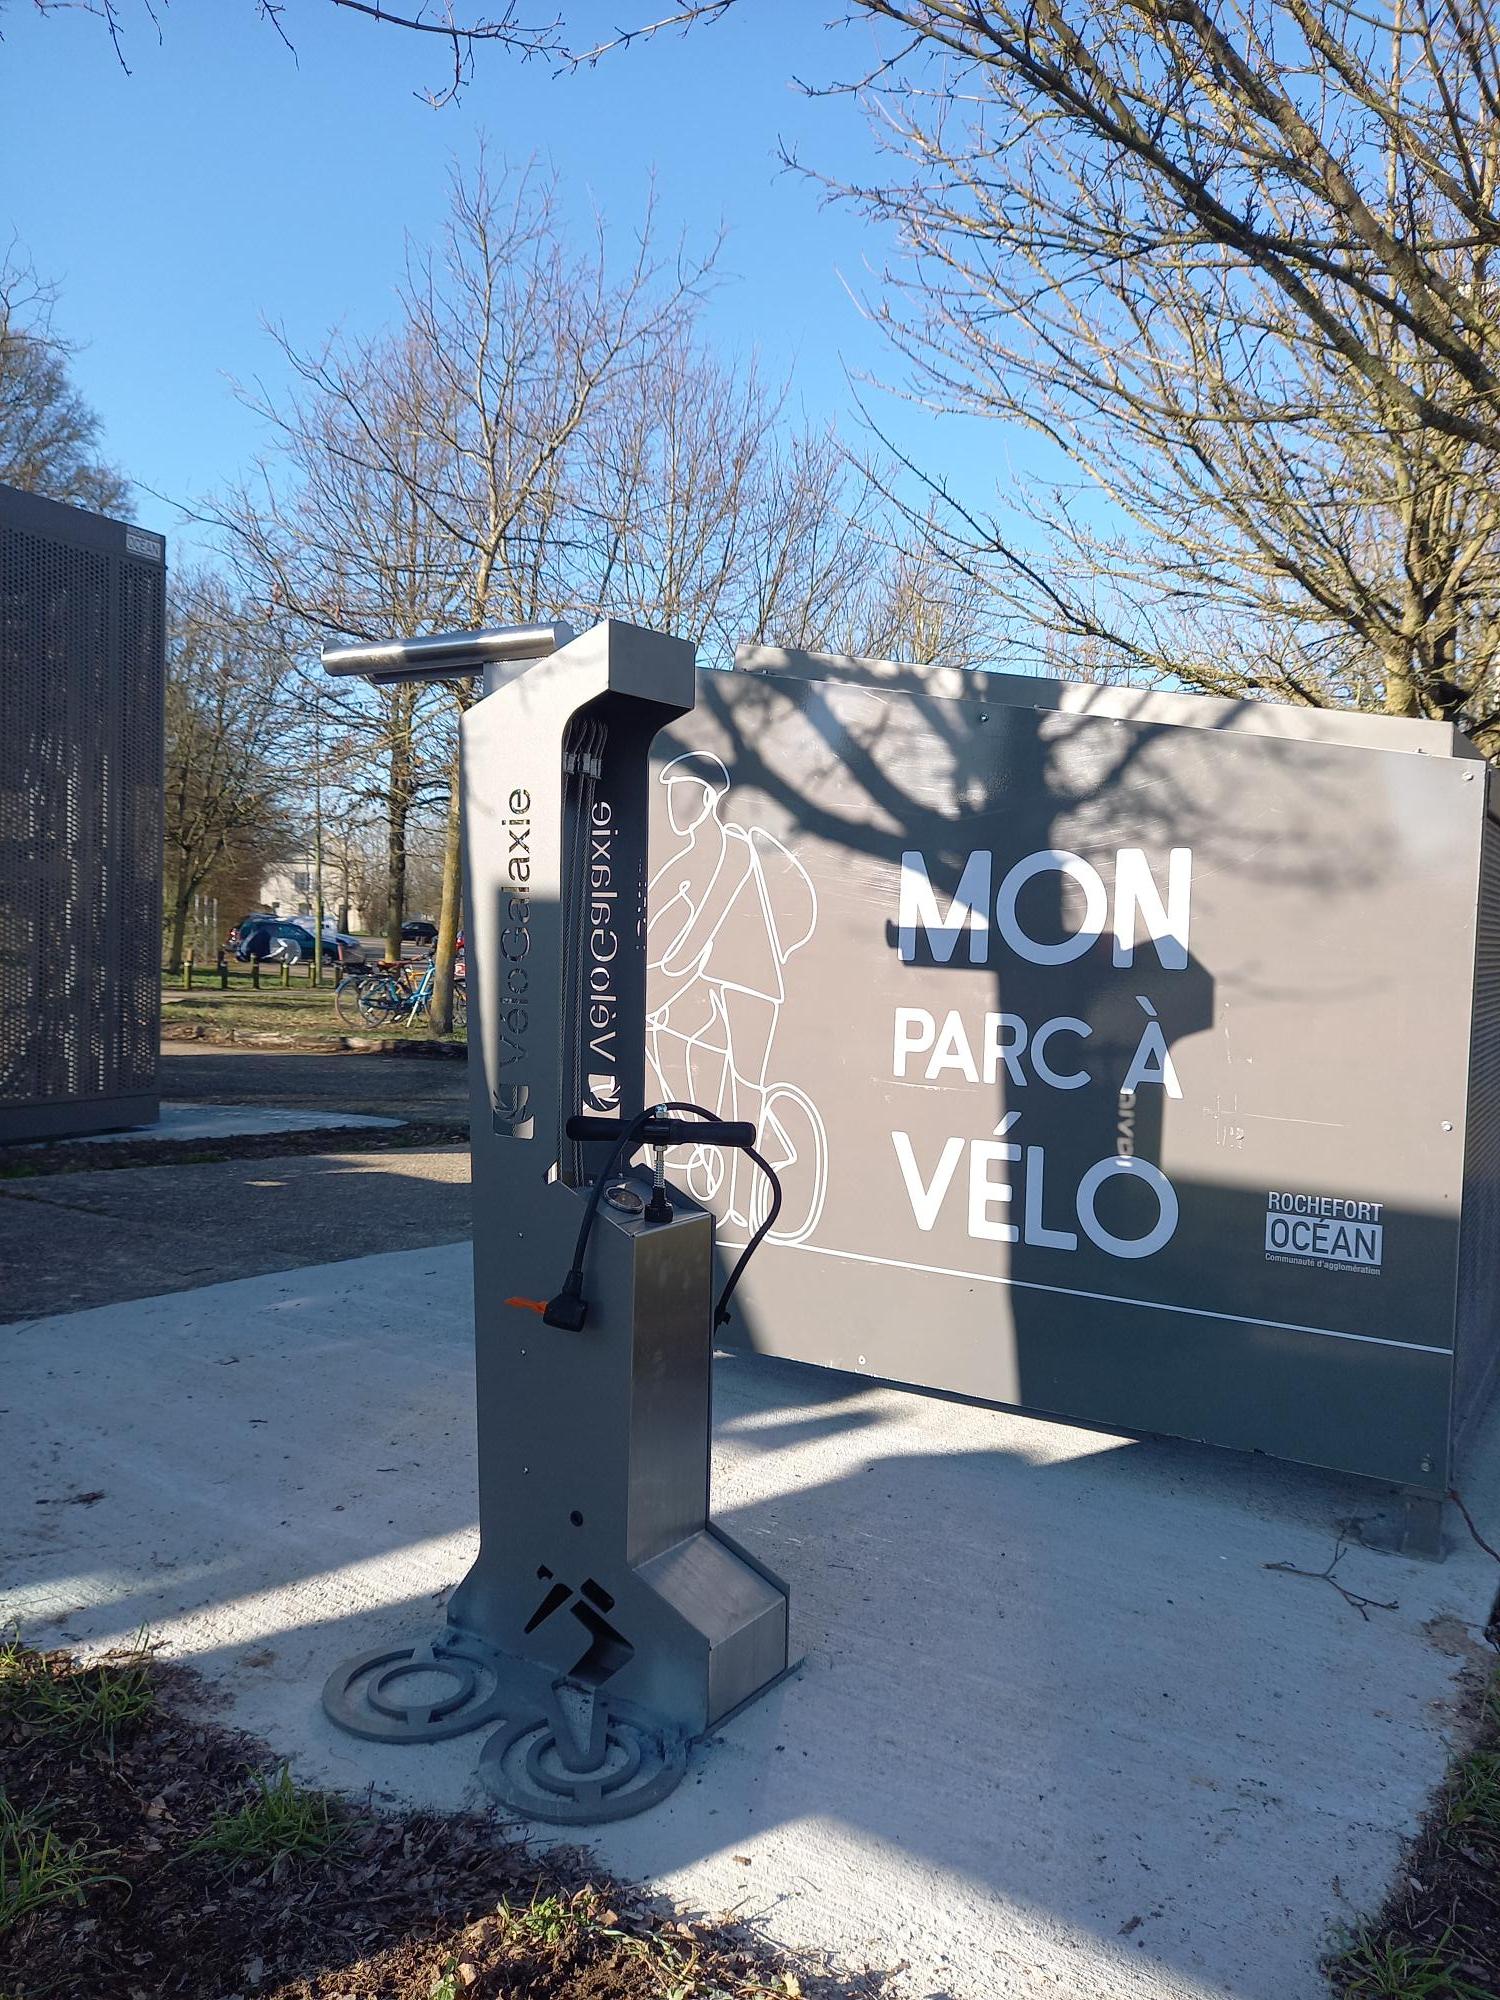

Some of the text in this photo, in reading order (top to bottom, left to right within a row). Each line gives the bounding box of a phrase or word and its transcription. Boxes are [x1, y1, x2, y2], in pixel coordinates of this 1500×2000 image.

[897, 847, 1192, 970] MON
[892, 995, 1184, 1100] PARC À
[890, 1110, 1180, 1260] VÉLO
[1268, 1191, 1384, 1222] ROCHEFORT
[1265, 1253, 1381, 1276] Communauté d'agglomération
[1270, 1218, 1376, 1261] OCÉAN
